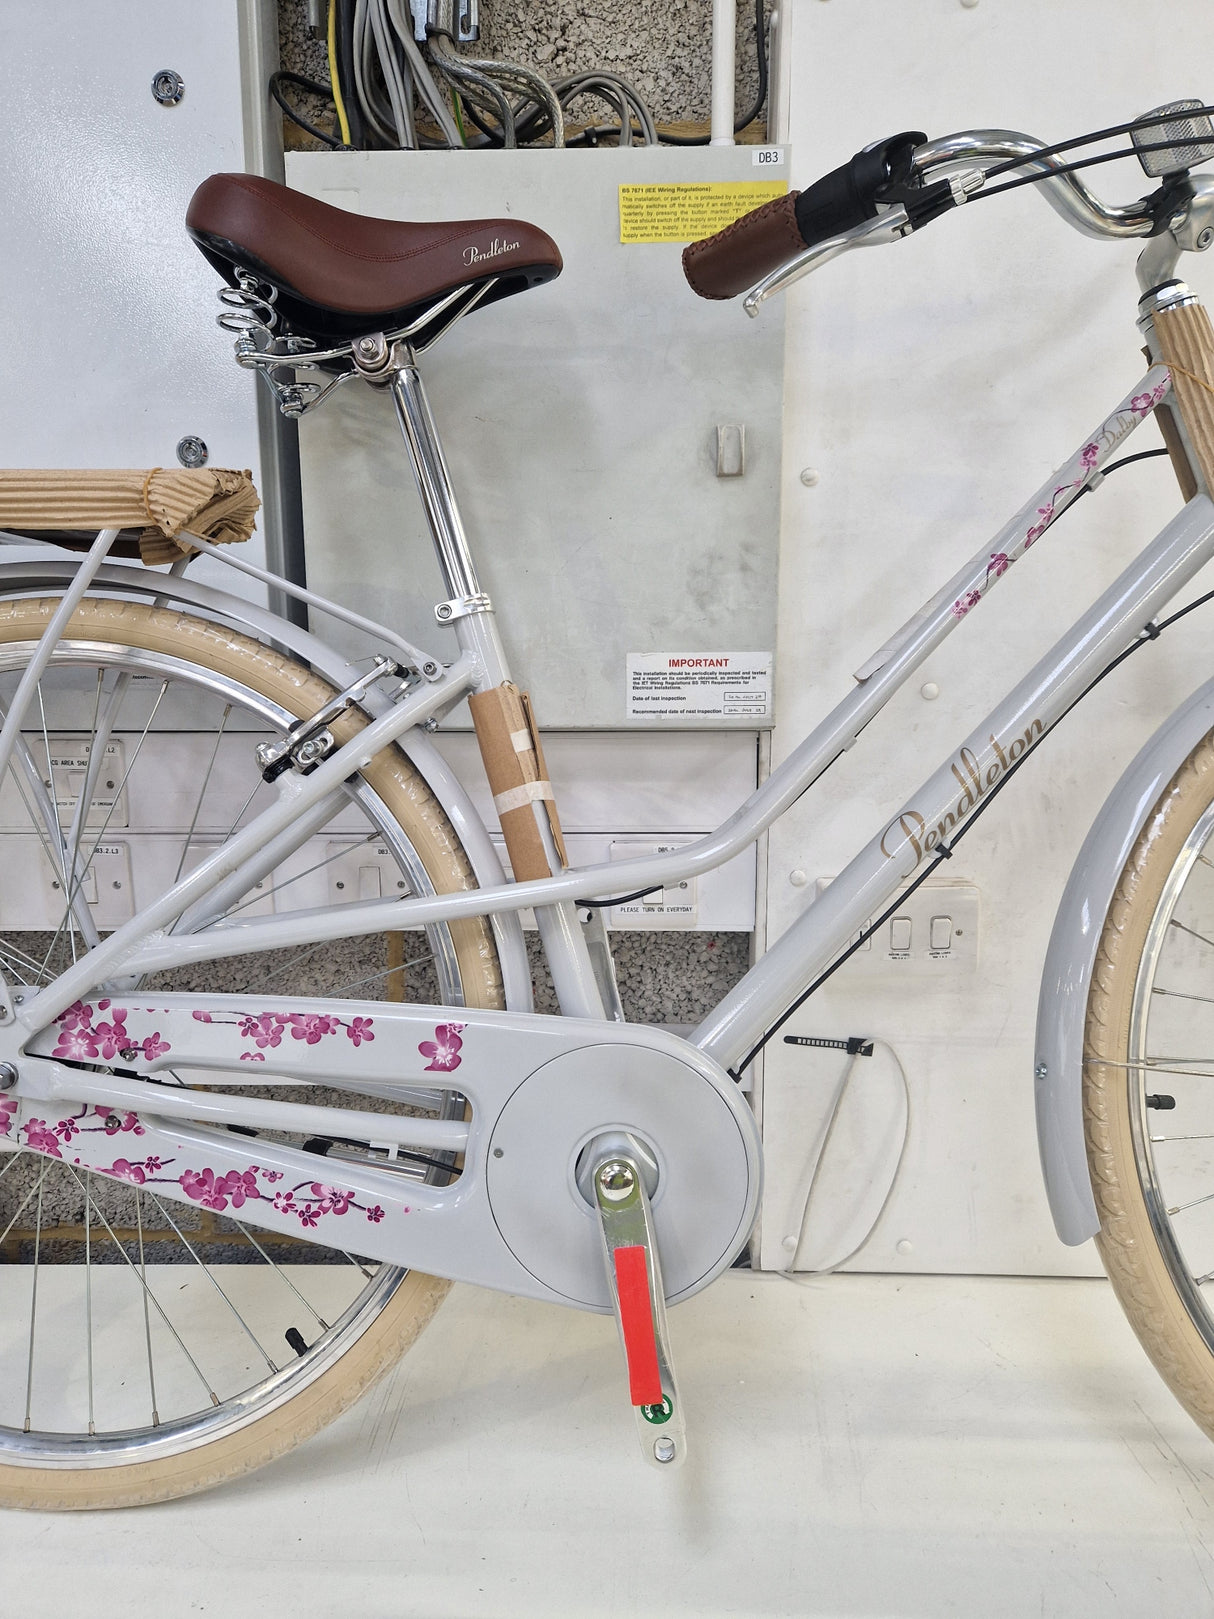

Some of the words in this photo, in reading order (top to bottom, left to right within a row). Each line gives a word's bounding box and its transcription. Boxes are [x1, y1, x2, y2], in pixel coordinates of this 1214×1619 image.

[758, 151, 778, 163] DB3
[657, 186, 675, 194] Wiring
[463, 238, 520, 267] Pendleton
[669, 658, 730, 668] IMPORTANT
[880, 718, 1047, 879] Pendleton
